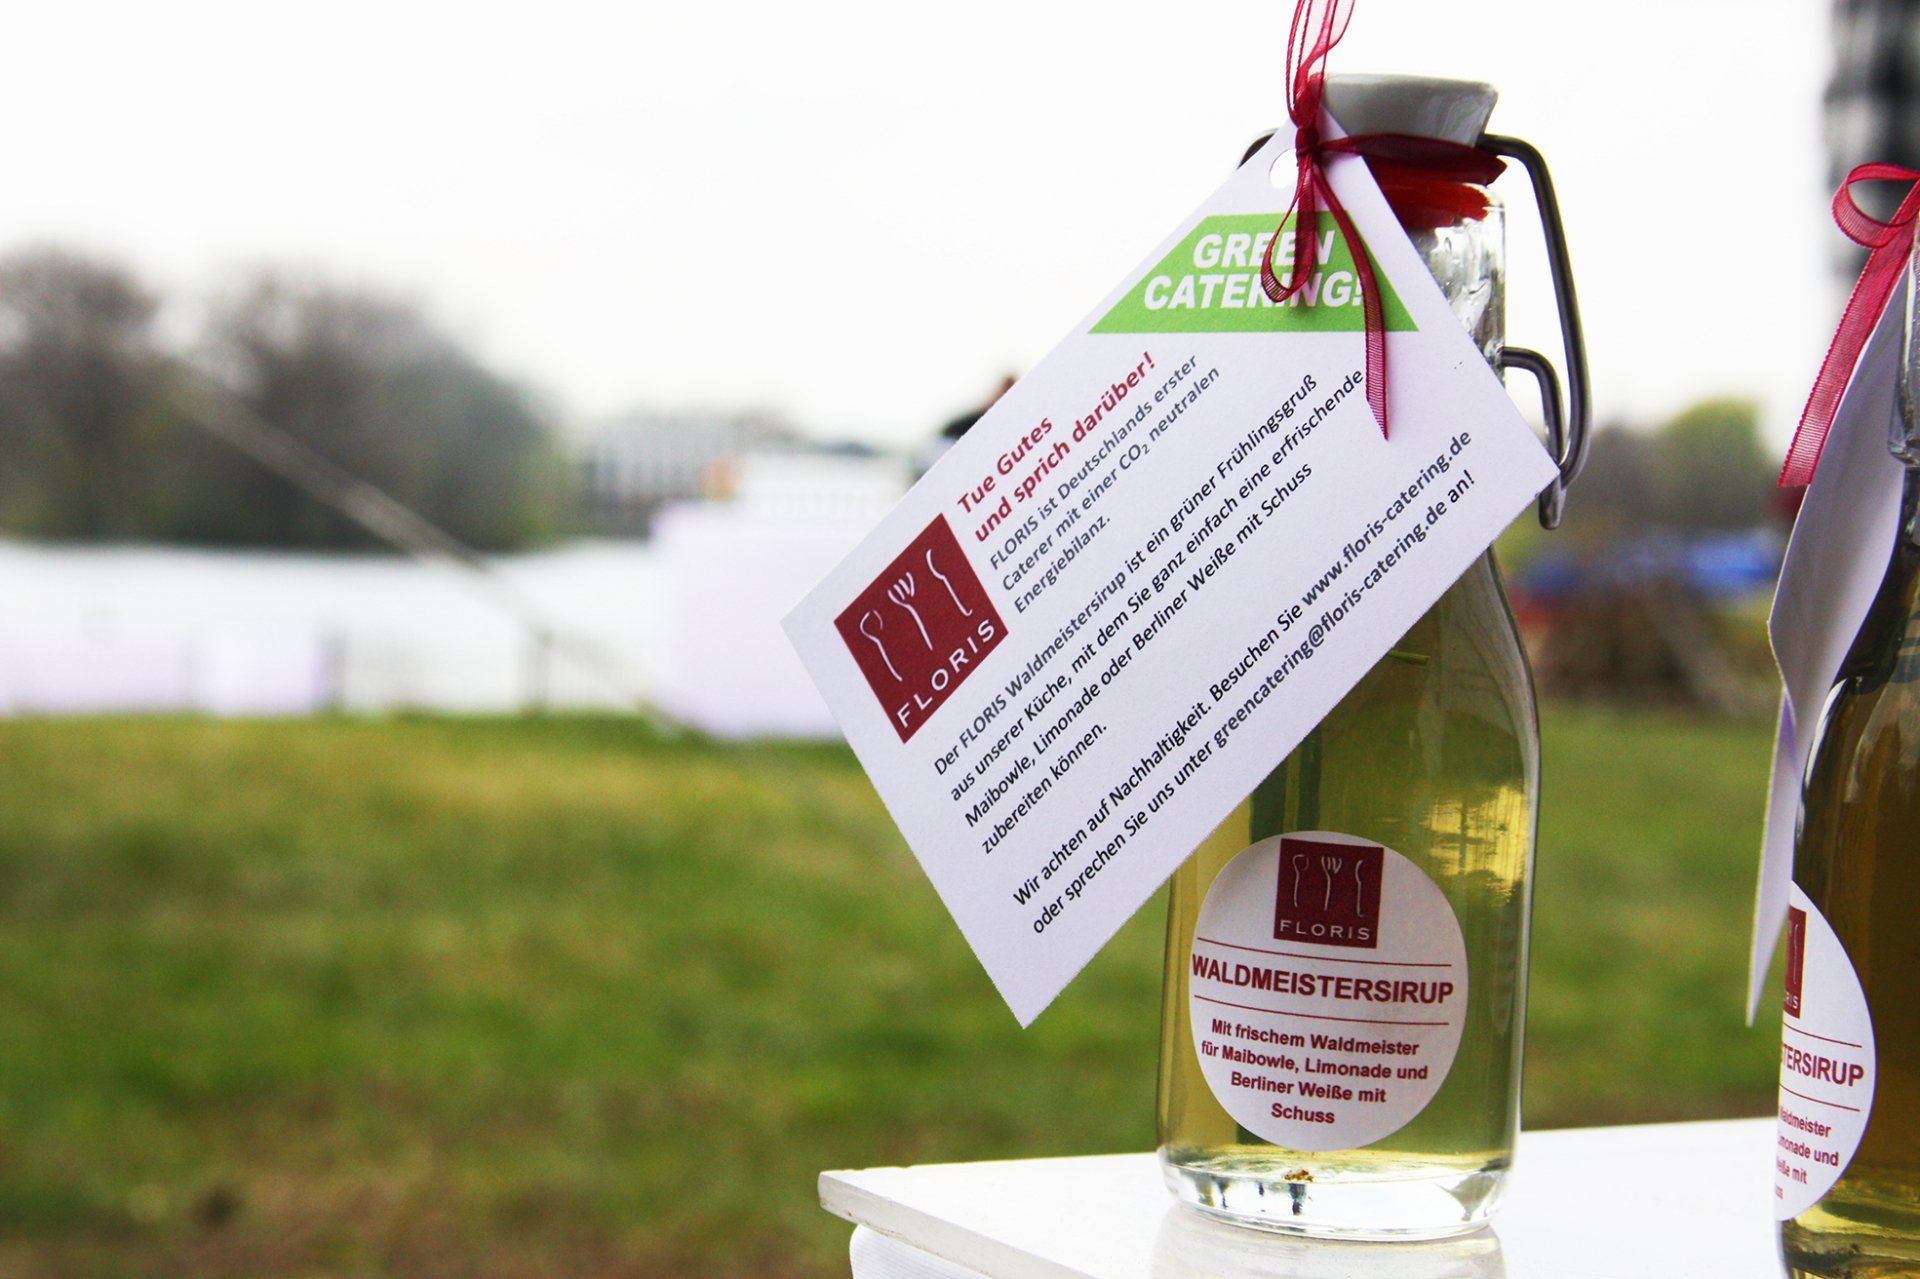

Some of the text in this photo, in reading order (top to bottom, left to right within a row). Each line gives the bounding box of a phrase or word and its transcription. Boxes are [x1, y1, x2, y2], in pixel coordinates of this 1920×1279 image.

[1193, 230, 1335, 268] GREEN
[957, 417, 1053, 514] Tue Gutes
[975, 351, 1155, 542] und sprich darüber!
[989, 355, 1196, 571] FLORIS ist Deutschlands erster
[1002, 534, 1053, 591] Caterer
[1055, 507, 1082, 538] mit
[1081, 468, 1117, 511] einer
[1148, 367, 1220, 442] neutralen
[934, 374, 1317, 776] Der FLORIS Waldmeistersirup ist ein grüner Frühlingsgruß
[950, 369, 1364, 802] aus unserer Küche, mit dem Sie ganz einfach eine erfrischende
[1014, 515, 1111, 614] Energiebilanz.
[896, 619, 995, 728] FLORIS
[964, 463, 1312, 828] Maibowle, Limonade oder Berliner Weiße mit Schuss
[1012, 432, 1472, 906] Wir achten auf Nachhaltigkeit. Besuchen Sie www.floris-catering.de
[1033, 469, 1475, 934] oder sprechen Sie uns unter greencatering@floris-catering.de an!
[981, 724, 1107, 855] zubereiten können.
[1192, 954, 1454, 1004] WALDMEISTERSIRUP
[1279, 920, 1371, 941] FLORIS
[1201, 1040, 1429, 1080] für Maibowle, Limonade und
[1211, 1018, 1420, 1055] Mit frischem Waldmeister
[1782, 1043, 1865, 1087] TERSIRUP
[1231, 1071, 1387, 1103] Berliner Weiße mit
[1271, 1102, 1336, 1124] Schuss
[1792, 1167, 1807, 1185] mit
[1814, 1149, 1839, 1167] und
